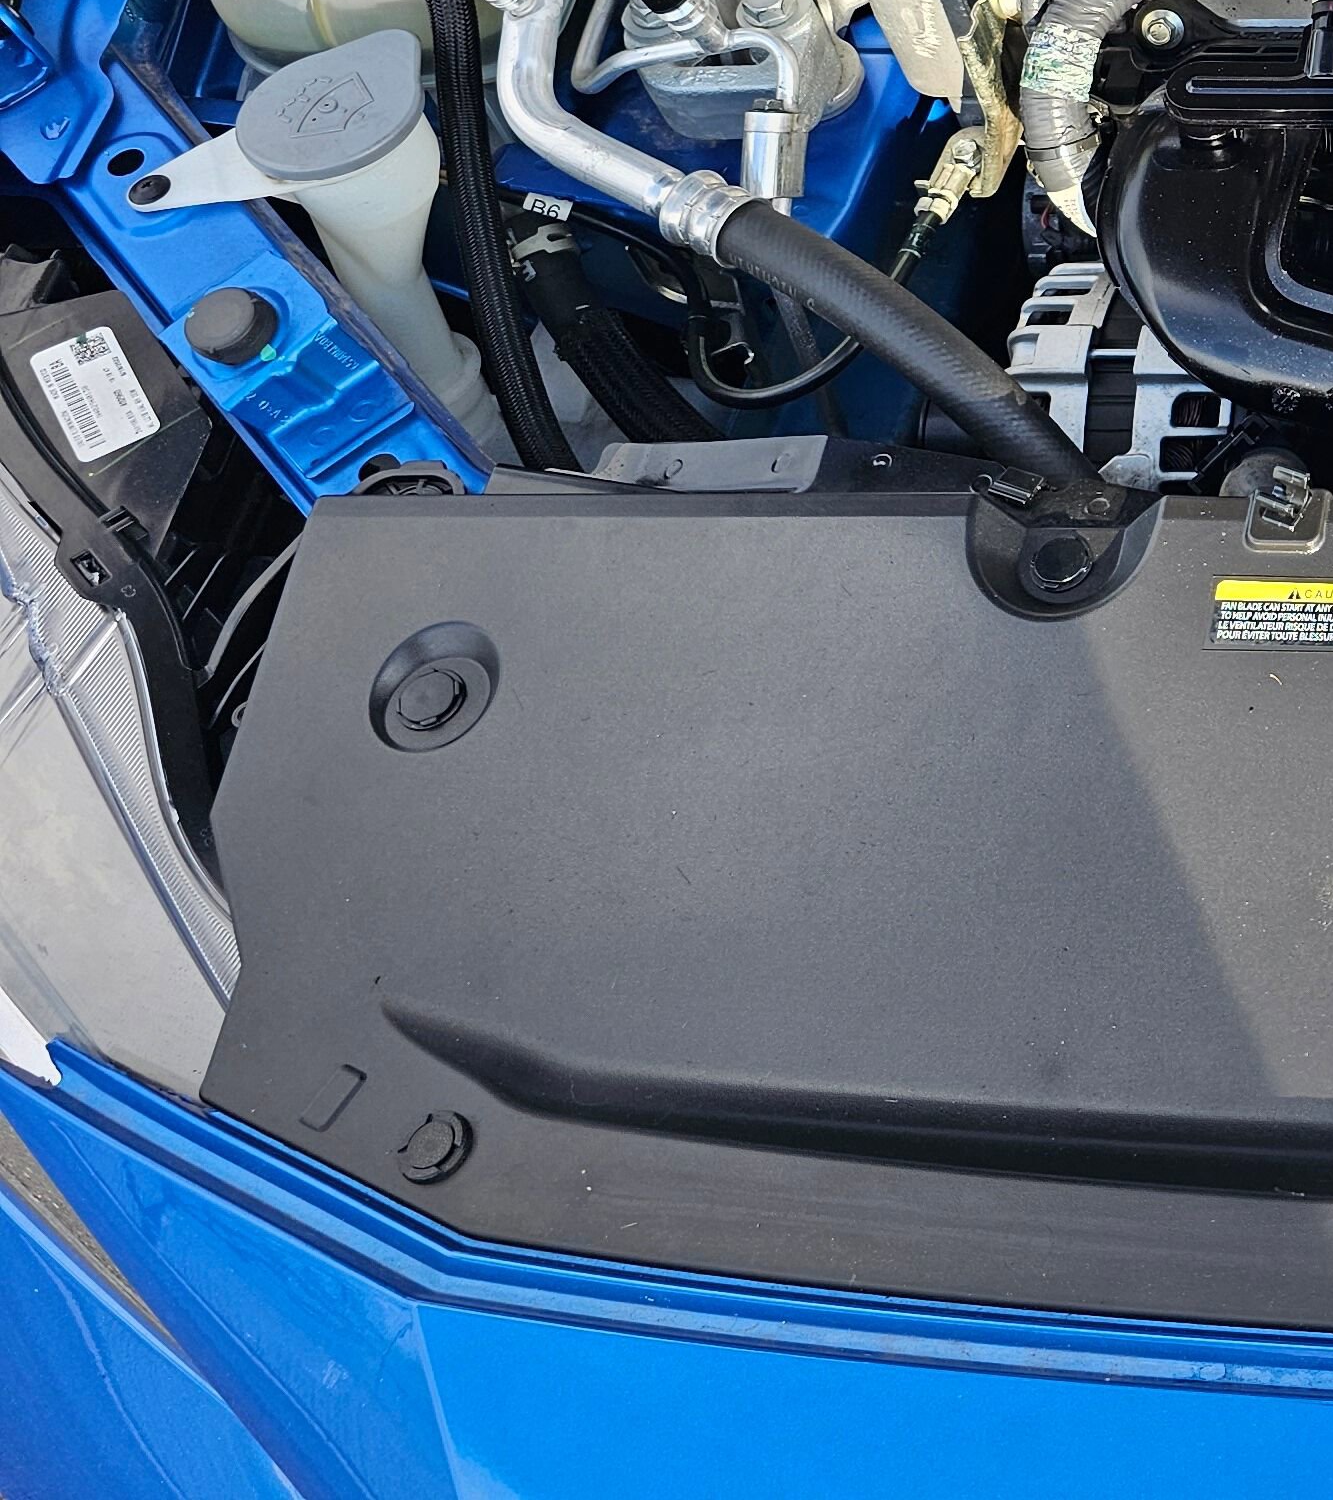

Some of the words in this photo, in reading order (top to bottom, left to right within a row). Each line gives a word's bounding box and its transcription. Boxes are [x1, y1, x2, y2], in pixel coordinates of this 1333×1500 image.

[532, 198, 561, 220] B6
[1220, 602, 1238, 611] FAN
[1238, 602, 1262, 612] BLADE
[1262, 602, 1280, 612] CAN
[1282, 602, 1304, 613] START
[1232, 612, 1252, 621] HELP
[1252, 612, 1278, 621] AVOID
[1278, 612, 1317, 622] PERSONAL
[1228, 621, 1284, 631] VENTILATEUR
[1284, 622, 1316, 631] RISQUE
[1216, 630, 1242, 640] POUR
[1242, 630, 1271, 640] ÉVITER
[1270, 631, 1298, 641] TOUTE
